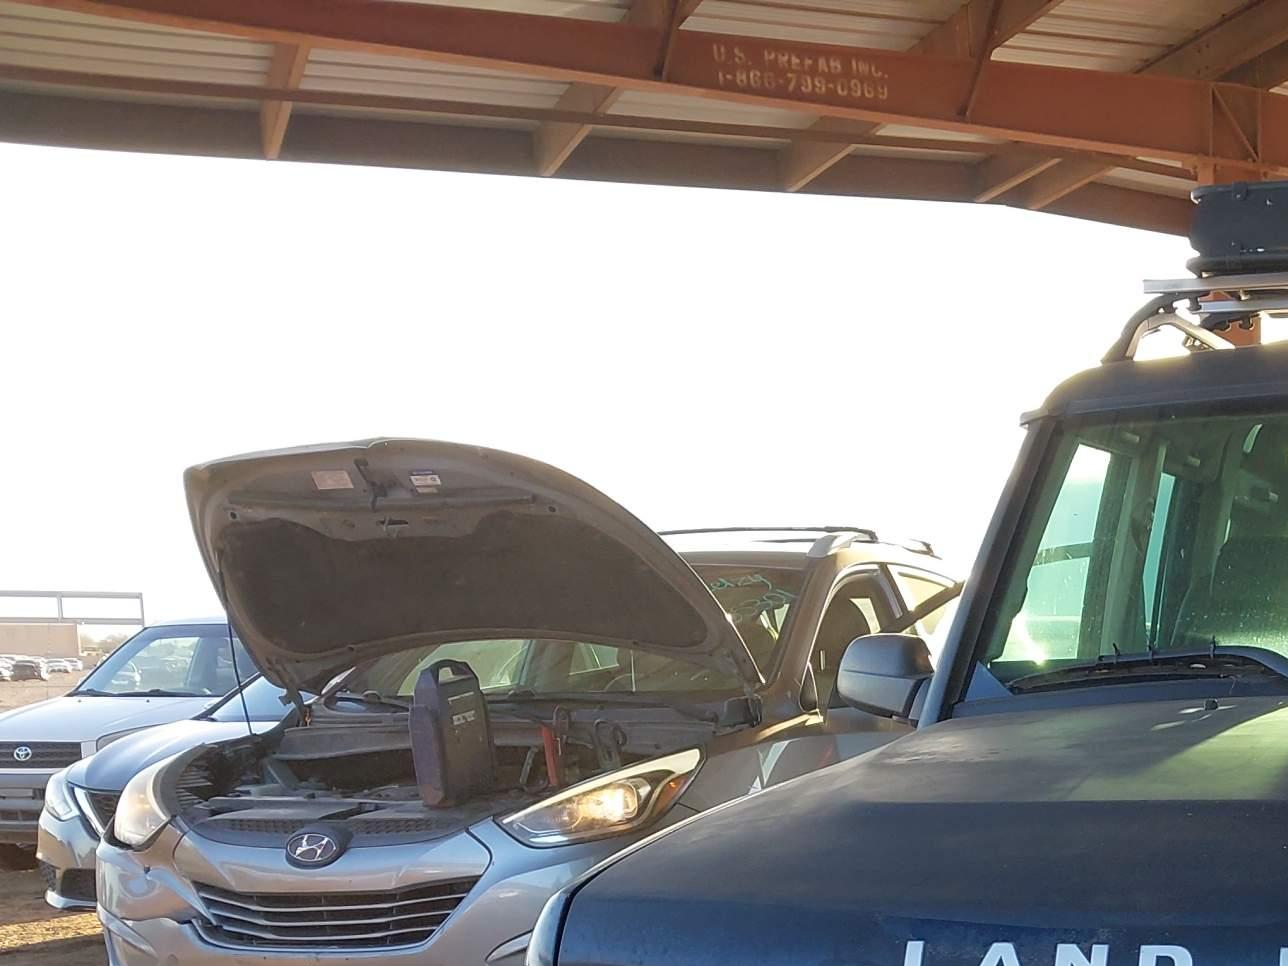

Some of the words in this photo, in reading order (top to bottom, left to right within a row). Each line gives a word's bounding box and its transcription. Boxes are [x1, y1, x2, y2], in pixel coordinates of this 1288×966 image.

[712, 43, 752, 65] U.S.
[764, 49, 842, 73] PREFAB
[851, 57, 889, 78] INC.
[717, 69, 889, 99] 1-866-799-0969
